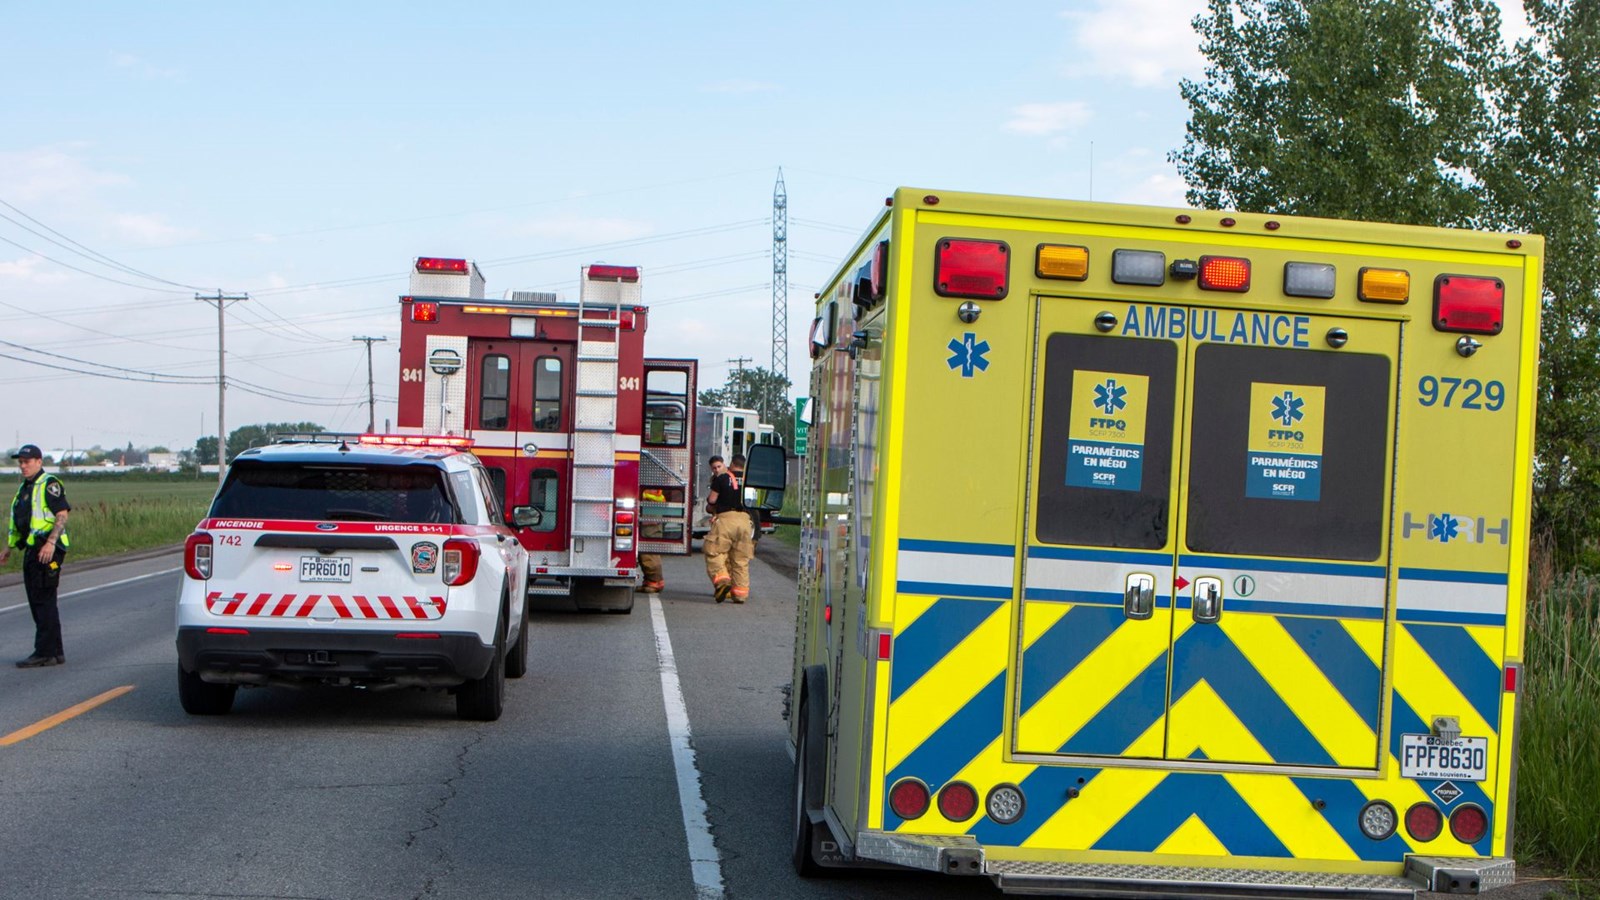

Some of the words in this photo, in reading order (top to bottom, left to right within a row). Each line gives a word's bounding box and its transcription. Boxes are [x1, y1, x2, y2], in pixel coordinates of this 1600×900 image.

[1121, 304, 1310, 348] AMBULANCE
[402, 368, 423, 382] 341
[619, 376, 640, 390] 341
[1418, 375, 1505, 411] 9729
[1089, 417, 1126, 431] FTPQ
[1268, 429, 1304, 443] FTPQ
[1072, 445, 1140, 459] PARAMÉDICS
[1083, 457, 1098, 467] EN
[1099, 457, 1127, 469] NÉGO
[1251, 457, 1318, 469] PARAMÉDICS
[1263, 468, 1277, 478] EN
[1278, 468, 1306, 479] NÉGO
[215, 520, 265, 529] INCENDIE
[374, 524, 419, 532] URGENCE
[219, 534, 242, 546] 742
[302, 562, 350, 577] FPR6010
[1405, 745, 1484, 770] FPF8630
